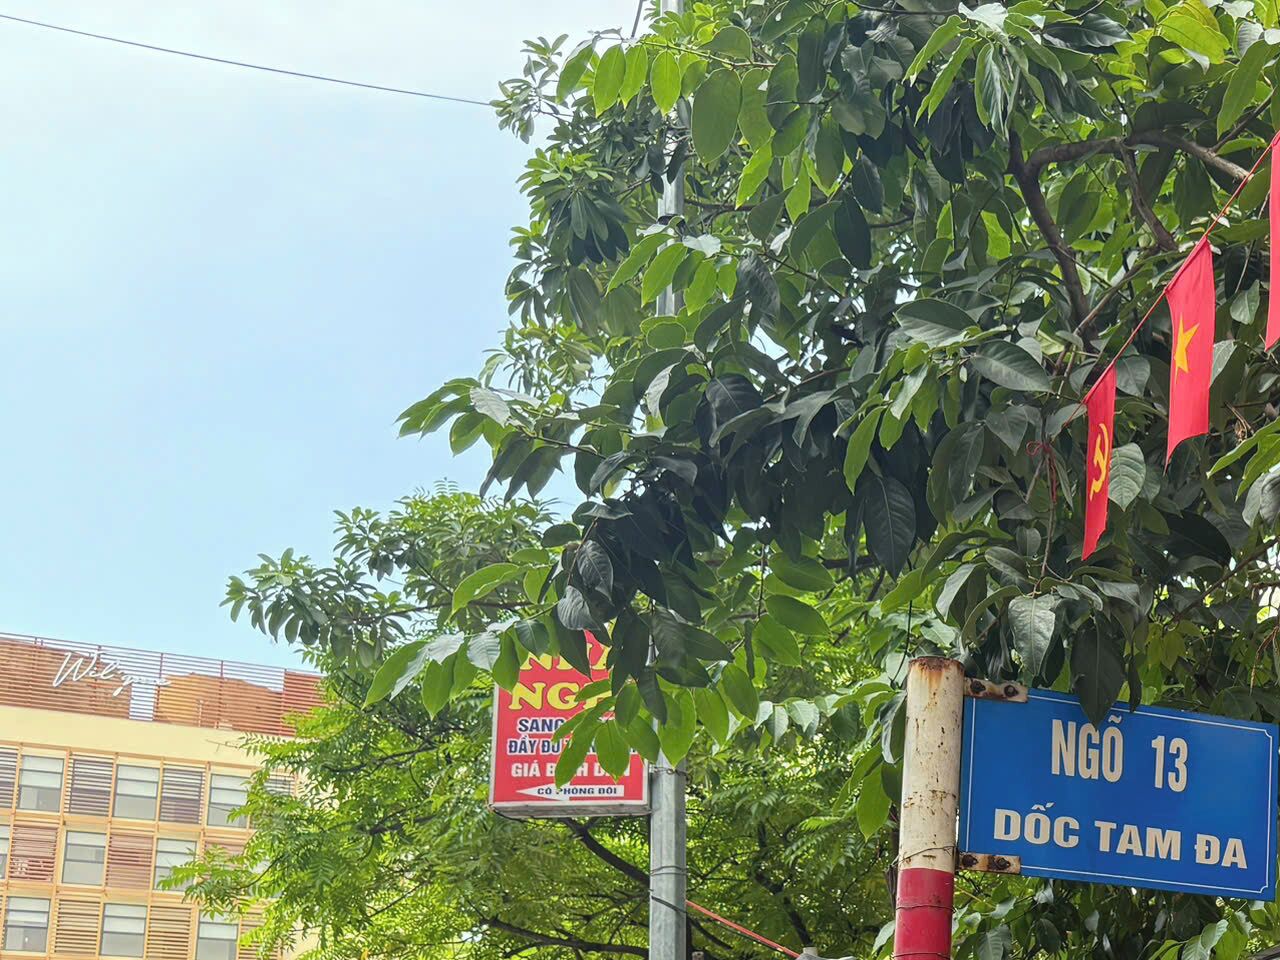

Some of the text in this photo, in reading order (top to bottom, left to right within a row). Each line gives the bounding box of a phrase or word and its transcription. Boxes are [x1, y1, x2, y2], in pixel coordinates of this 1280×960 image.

[511, 760, 541, 777] GIÁ
[1051, 715, 1190, 792] NGÕ 13
[993, 802, 1248, 870] DỐC TAM ĐA
